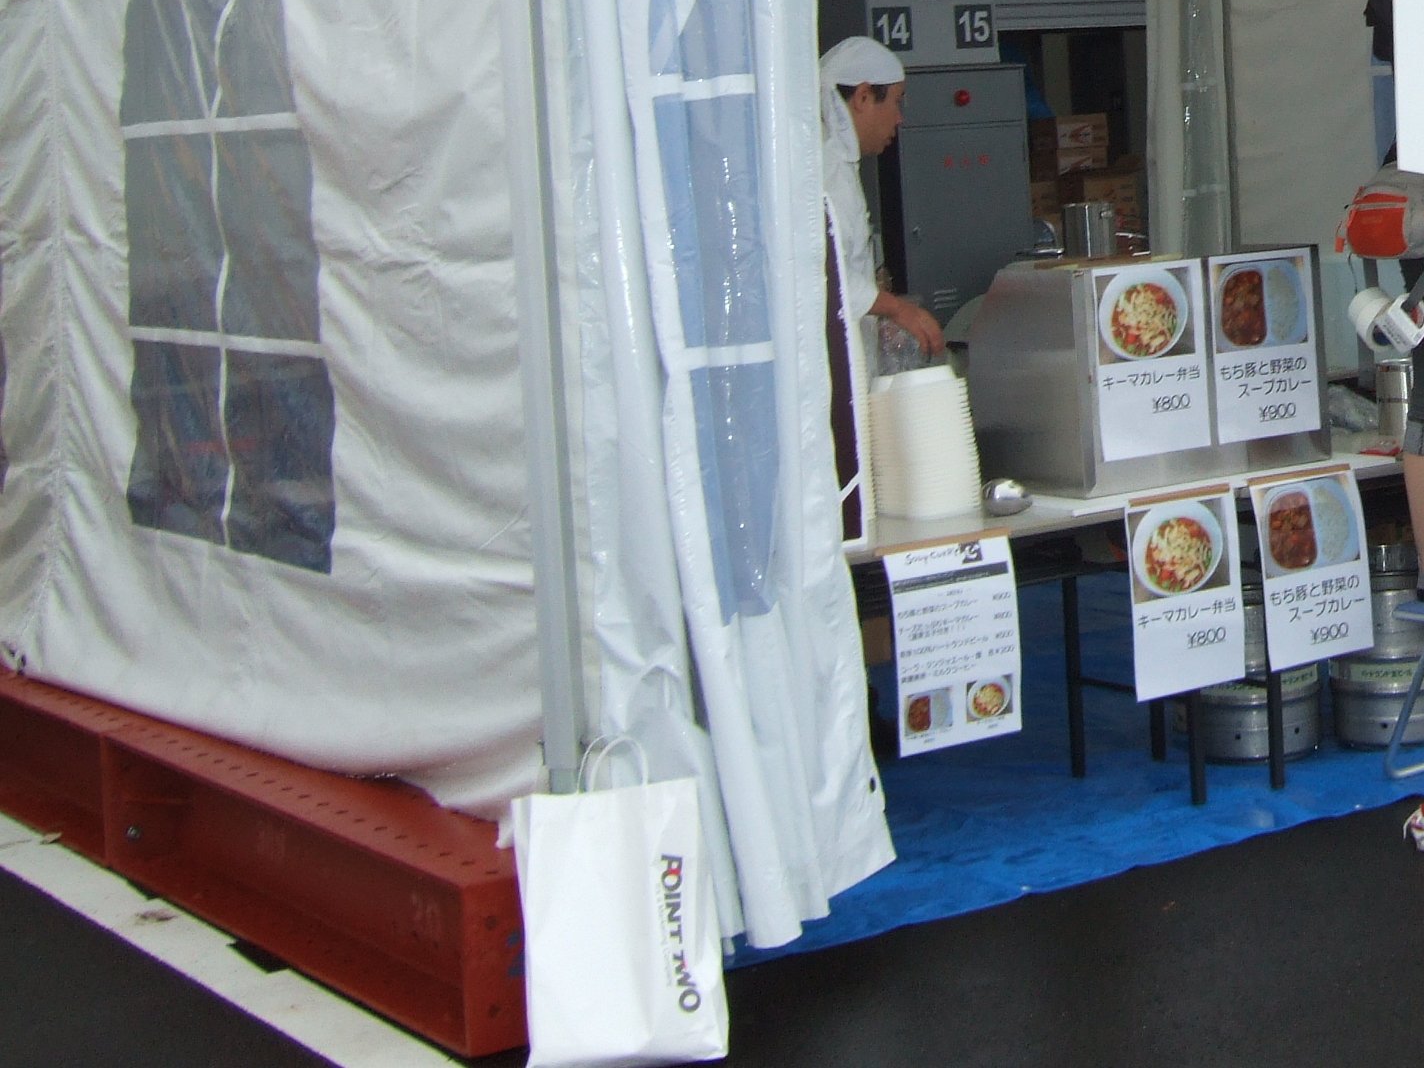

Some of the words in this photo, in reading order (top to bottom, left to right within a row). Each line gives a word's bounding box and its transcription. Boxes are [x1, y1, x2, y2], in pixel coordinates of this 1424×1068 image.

[876, 12, 911, 46] 14
[957, 9, 991, 43] 15
[1102, 365, 1202, 389] キーマカレー弁当
[1237, 377, 1312, 399] スープカレー
[1151, 393, 1192, 413] ¥800
[1258, 402, 1297, 421] ¥900
[1136, 598, 1237, 629] キーマカレー弁当
[1288, 595, 1366, 625] スープカレー
[1187, 626, 1227, 649] ¥800
[1310, 622, 1349, 644] ¥900
[660, 853, 683, 945] POINT
[671, 950, 702, 1014] TWO
